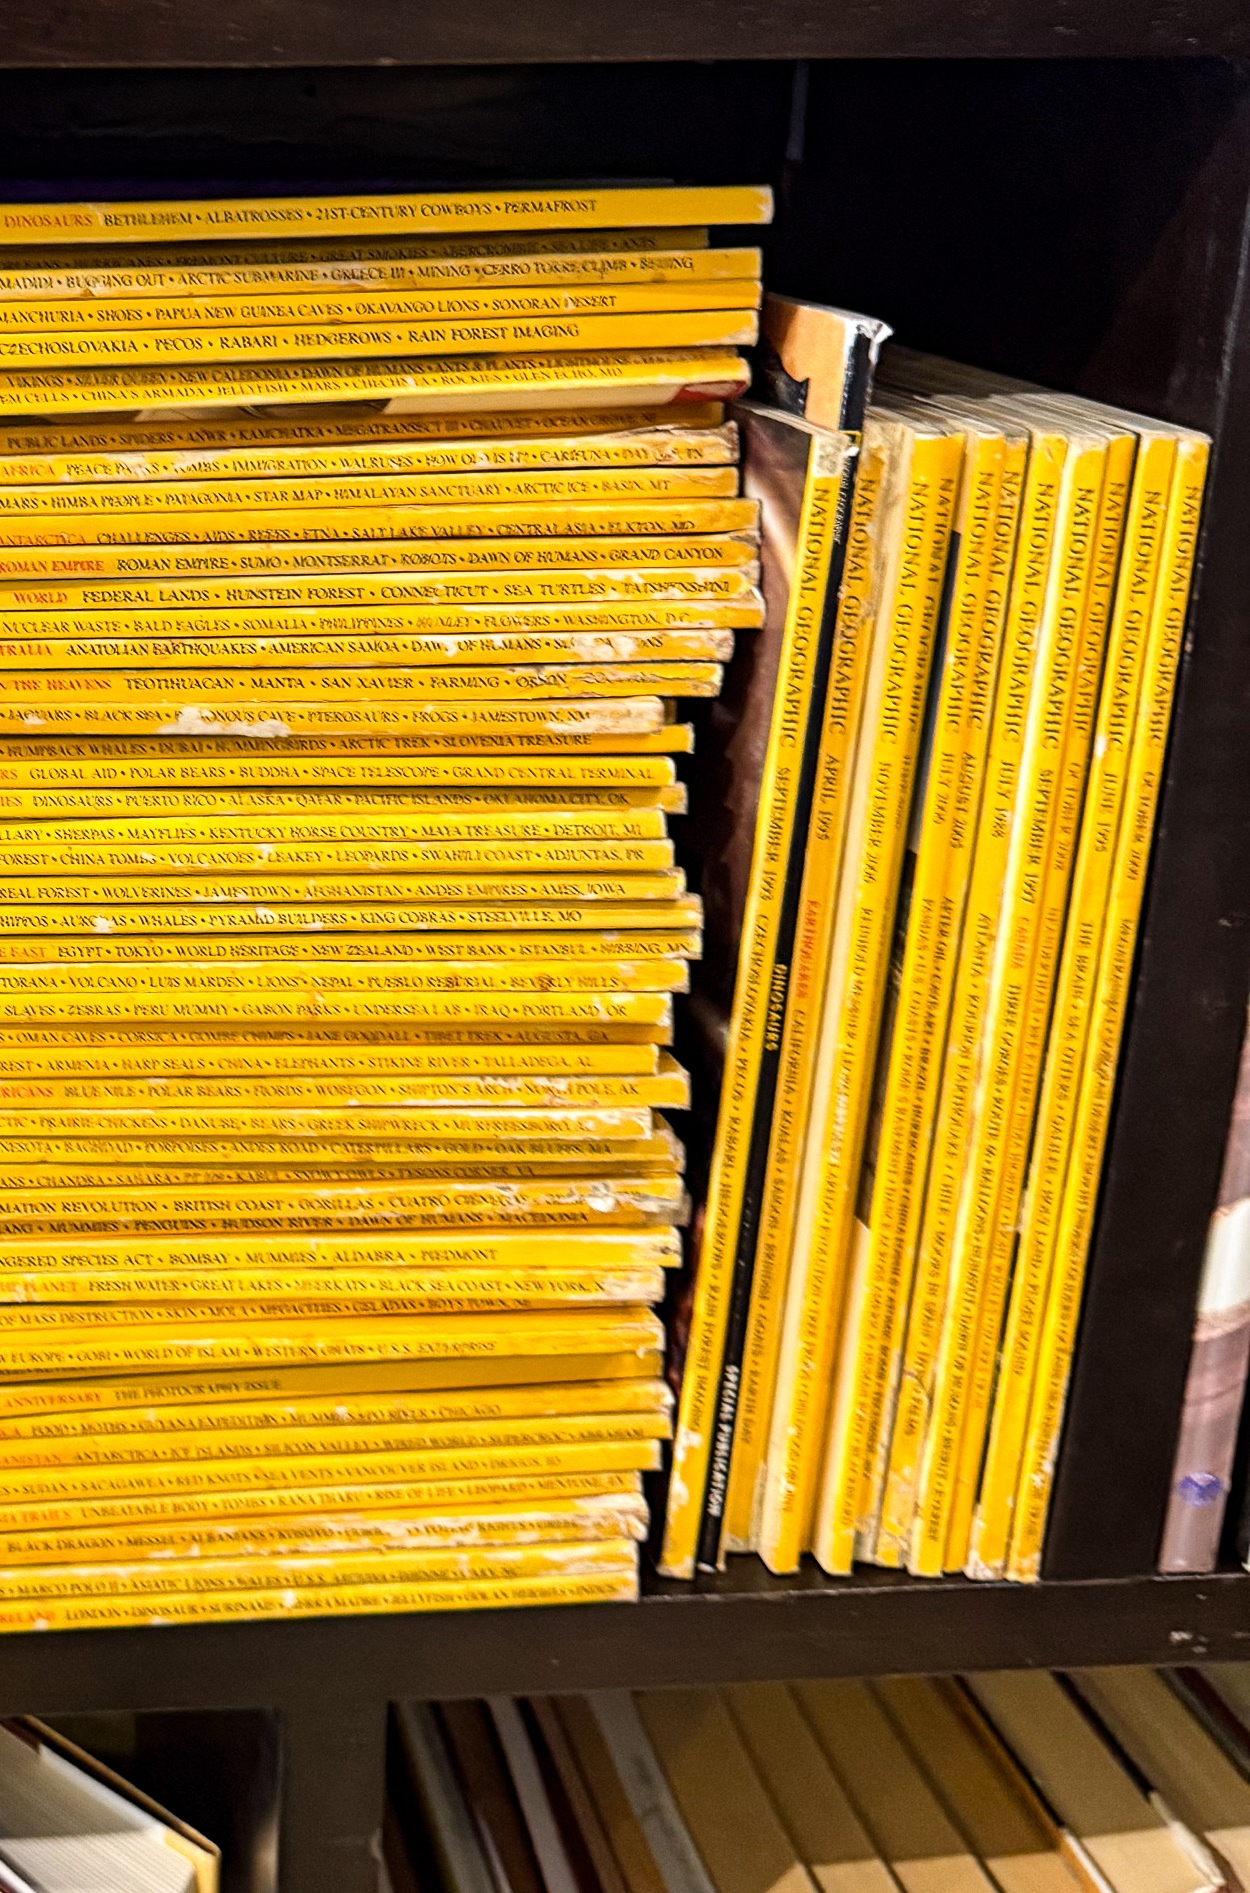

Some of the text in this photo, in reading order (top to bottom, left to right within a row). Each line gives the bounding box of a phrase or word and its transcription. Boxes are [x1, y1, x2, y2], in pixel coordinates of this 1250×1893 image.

[4, 214, 93, 228] DINOSAURS
[205, 209, 304, 224] ALBATROSSES
[504, 199, 597, 214] PERMAFROST
[97, 308, 143, 321] SHOES
[156, 306, 202, 320] PAPUA
[204, 305, 234, 319] NEW
[240, 304, 295, 318] GUINEA
[297, 302, 343, 316] CAVES
[155, 337, 203, 352] PECOS
[220, 335, 278, 349] RABARI
[294, 330, 392, 347] HEDGEROWS
[408, 328, 445, 343] RAIN
[452, 326, 508, 341] FOREST
[513, 323, 579, 340] IMAGING
[52, 559, 104, 572] EMPIRE
[117, 558, 171, 571] ROMAN
[175, 557, 229, 569] EMPIRE
[240, 555, 281, 569] SUMO
[293, 552, 388, 568] MONTSERRAT
[609, 548, 660, 561] GRAND
[664, 546, 723, 560] CANYON
[799, 488, 829, 600] NATIONAL
[847, 476, 879, 592] NATIONAL
[896, 481, 930, 603] NATIONAL
[1061, 487, 1093, 609] NATIONAL
[82, 590, 154, 603] FEDERAL
[159, 588, 210, 601] LANDS
[997, 482, 1054, 800] NATIONAL GEOGRAPHIC JULY
[777, 606, 815, 749] GEOGRAPHIC
[829, 596, 864, 735] GEOGRAPHIC
[879, 605, 914, 745] GEOGRAPHIC
[1043, 612, 1078, 750] GEOGRAPHIC
[767, 768, 792, 864] SEPTEMBER
[818, 752, 838, 805] APRIL
[1027, 769, 1050, 865] SEPTEMBER
[765, 963, 788, 1052] DINOSAURS
[61, 1200, 157, 1214] REVOLUTION
[62, 1254, 118, 1267] SPECIES
[124, 1253, 154, 1267] ACT
[169, 1252, 230, 1266] BOMBAY
[707, 1365, 739, 1517] SPECIAL PUBLICATION
